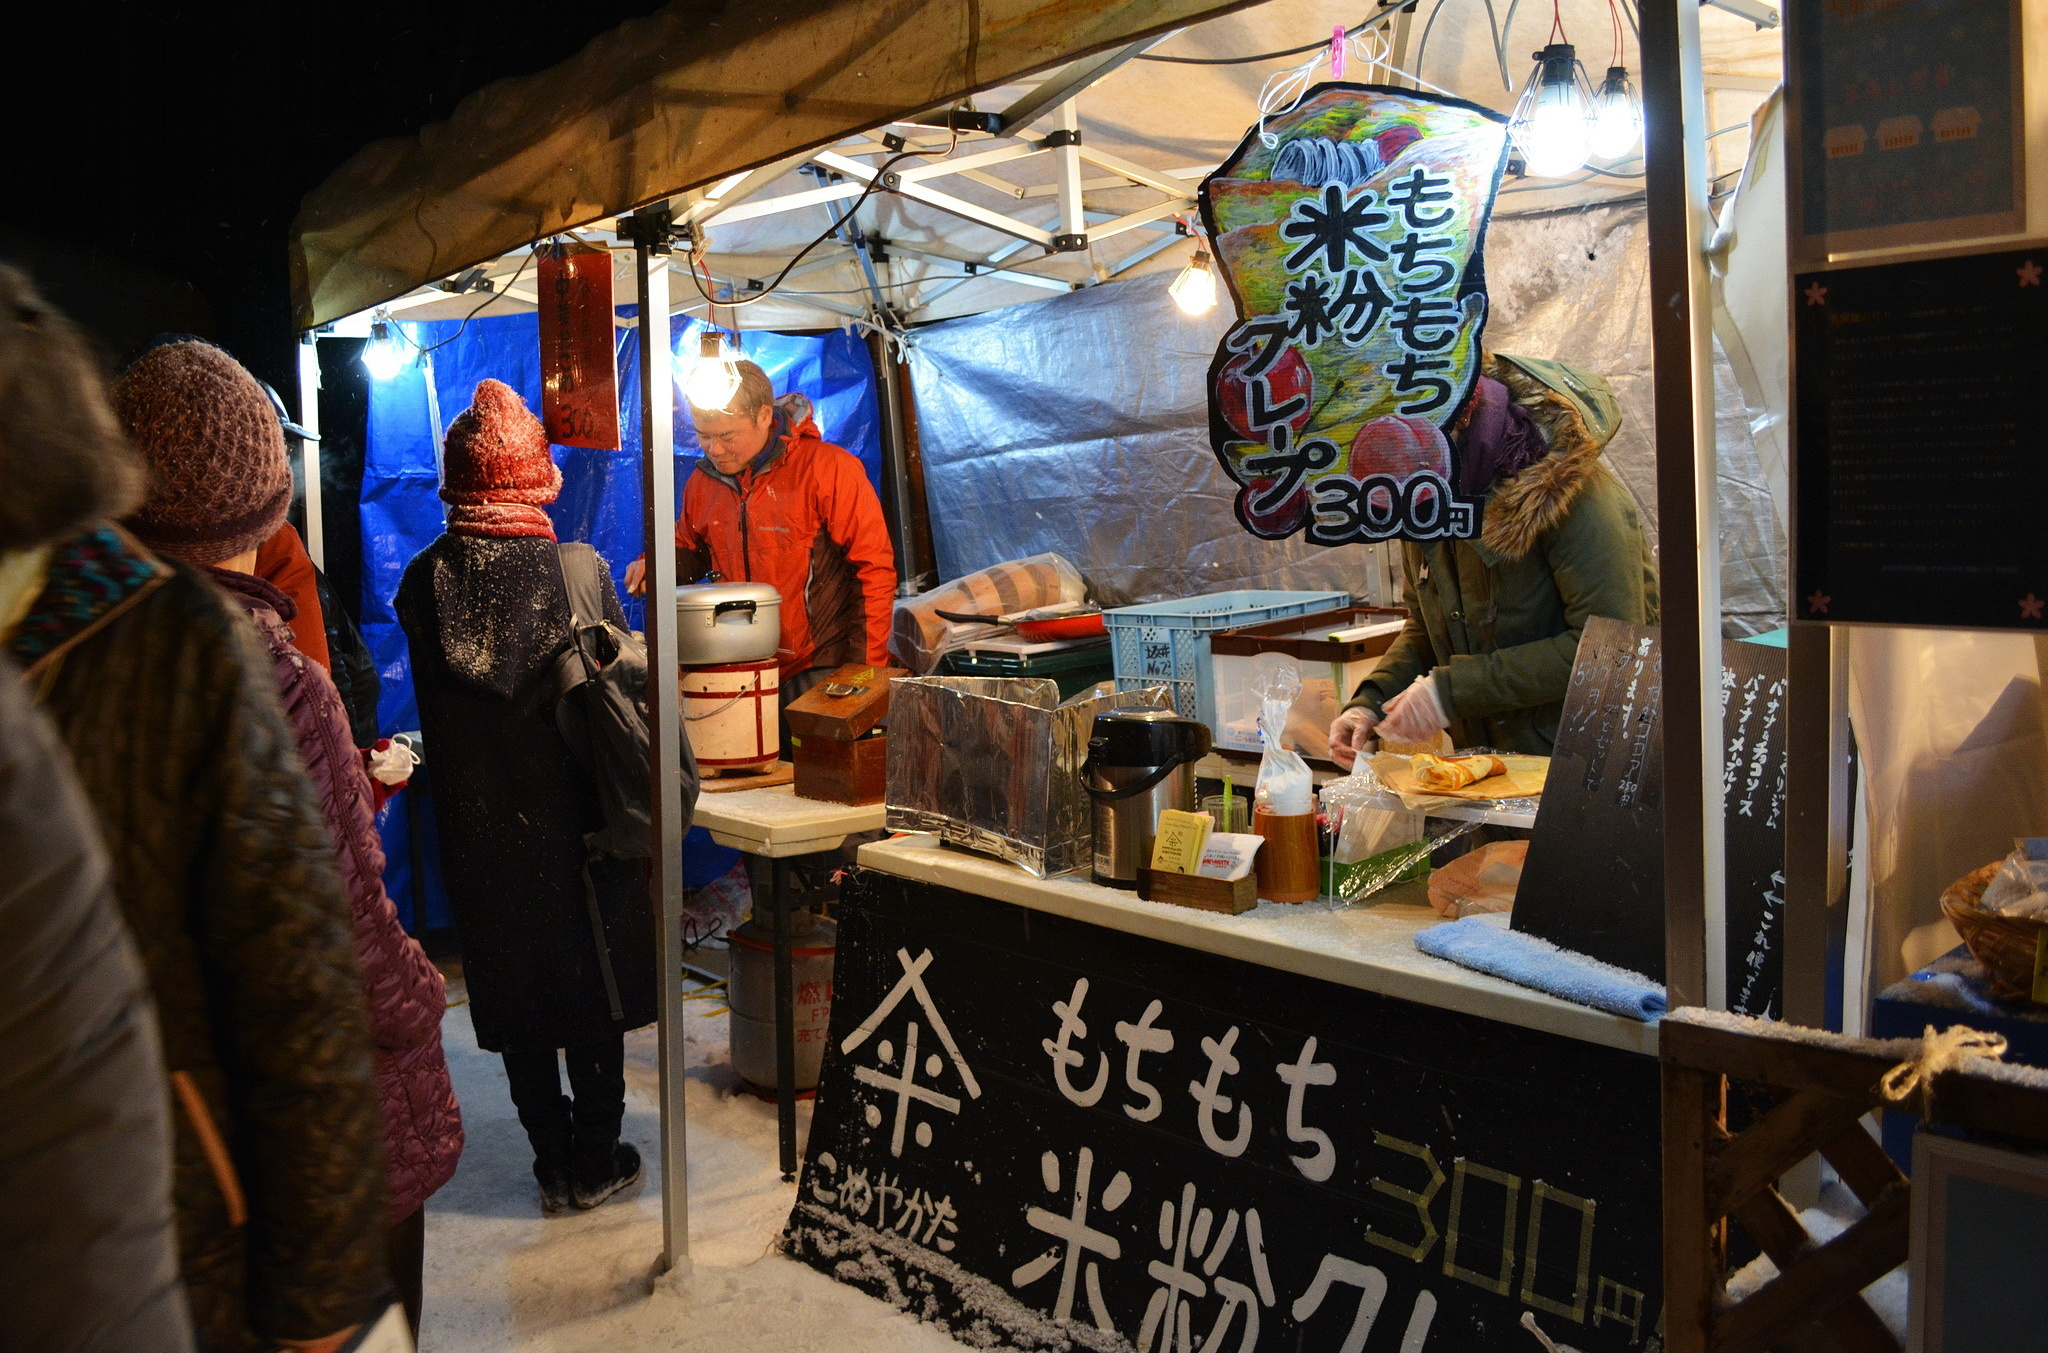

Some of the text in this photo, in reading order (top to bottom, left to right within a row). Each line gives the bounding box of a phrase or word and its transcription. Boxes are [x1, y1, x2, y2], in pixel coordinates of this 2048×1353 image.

[1284, 185, 1395, 346] 米粉
[1385, 167, 1463, 415] もちもち
[1230, 320, 1337, 513] クレープ
[1314, 478, 1474, 538] 300円
[1621, 637, 1655, 740] あります。
[1041, 977, 1338, 1183] もちもち
[812, 1152, 959, 1252] こめやかた
[1011, 1146, 1438, 1353] 米粉ク
[1364, 1129, 1646, 1347] 300円
